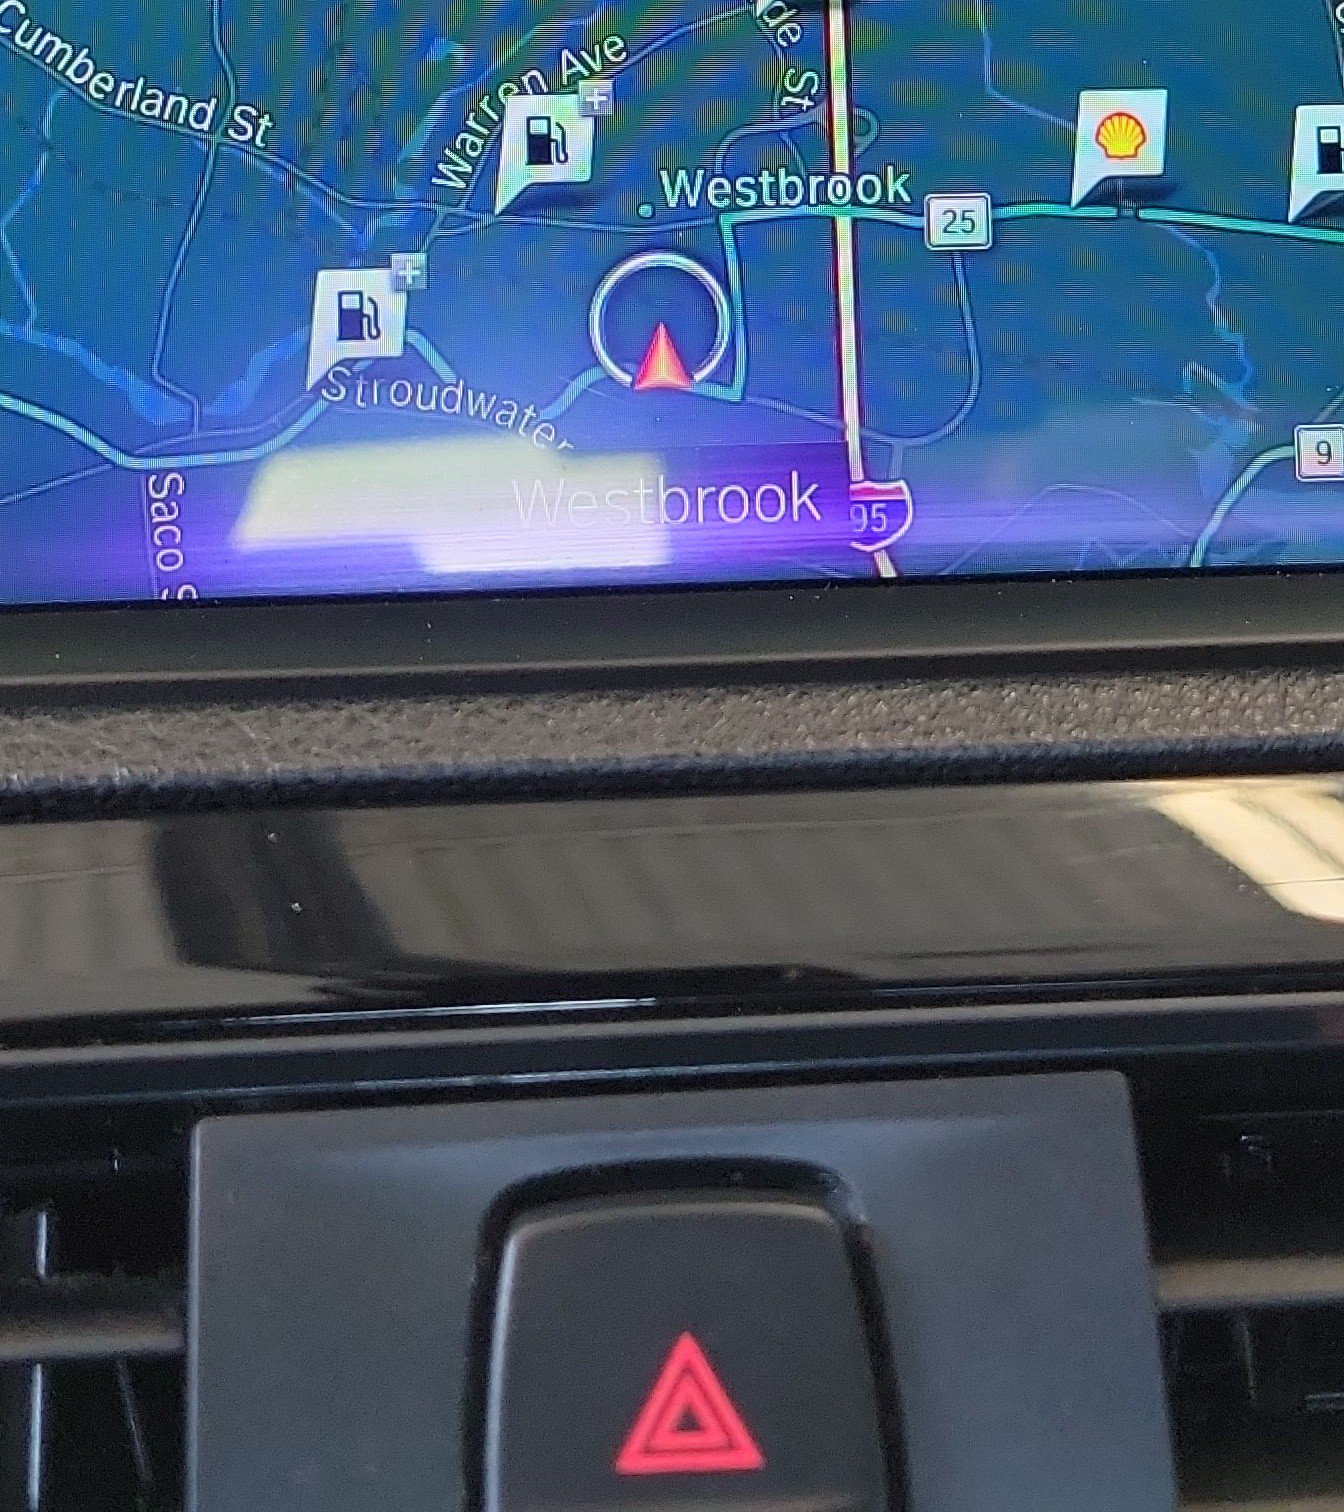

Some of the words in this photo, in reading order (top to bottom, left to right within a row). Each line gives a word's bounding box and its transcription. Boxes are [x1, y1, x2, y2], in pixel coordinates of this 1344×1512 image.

[780, 65, 821, 111] St
[226, 106, 275, 151] St
[431, 68, 549, 190] Warren
[560, 34, 629, 88] Ave
[660, 166, 913, 210] Westbrook
[941, 207, 977, 236] 25
[1317, 438, 1333, 468] 9
[512, 469, 822, 528] Westbrook
[148, 471, 186, 572] Saco
